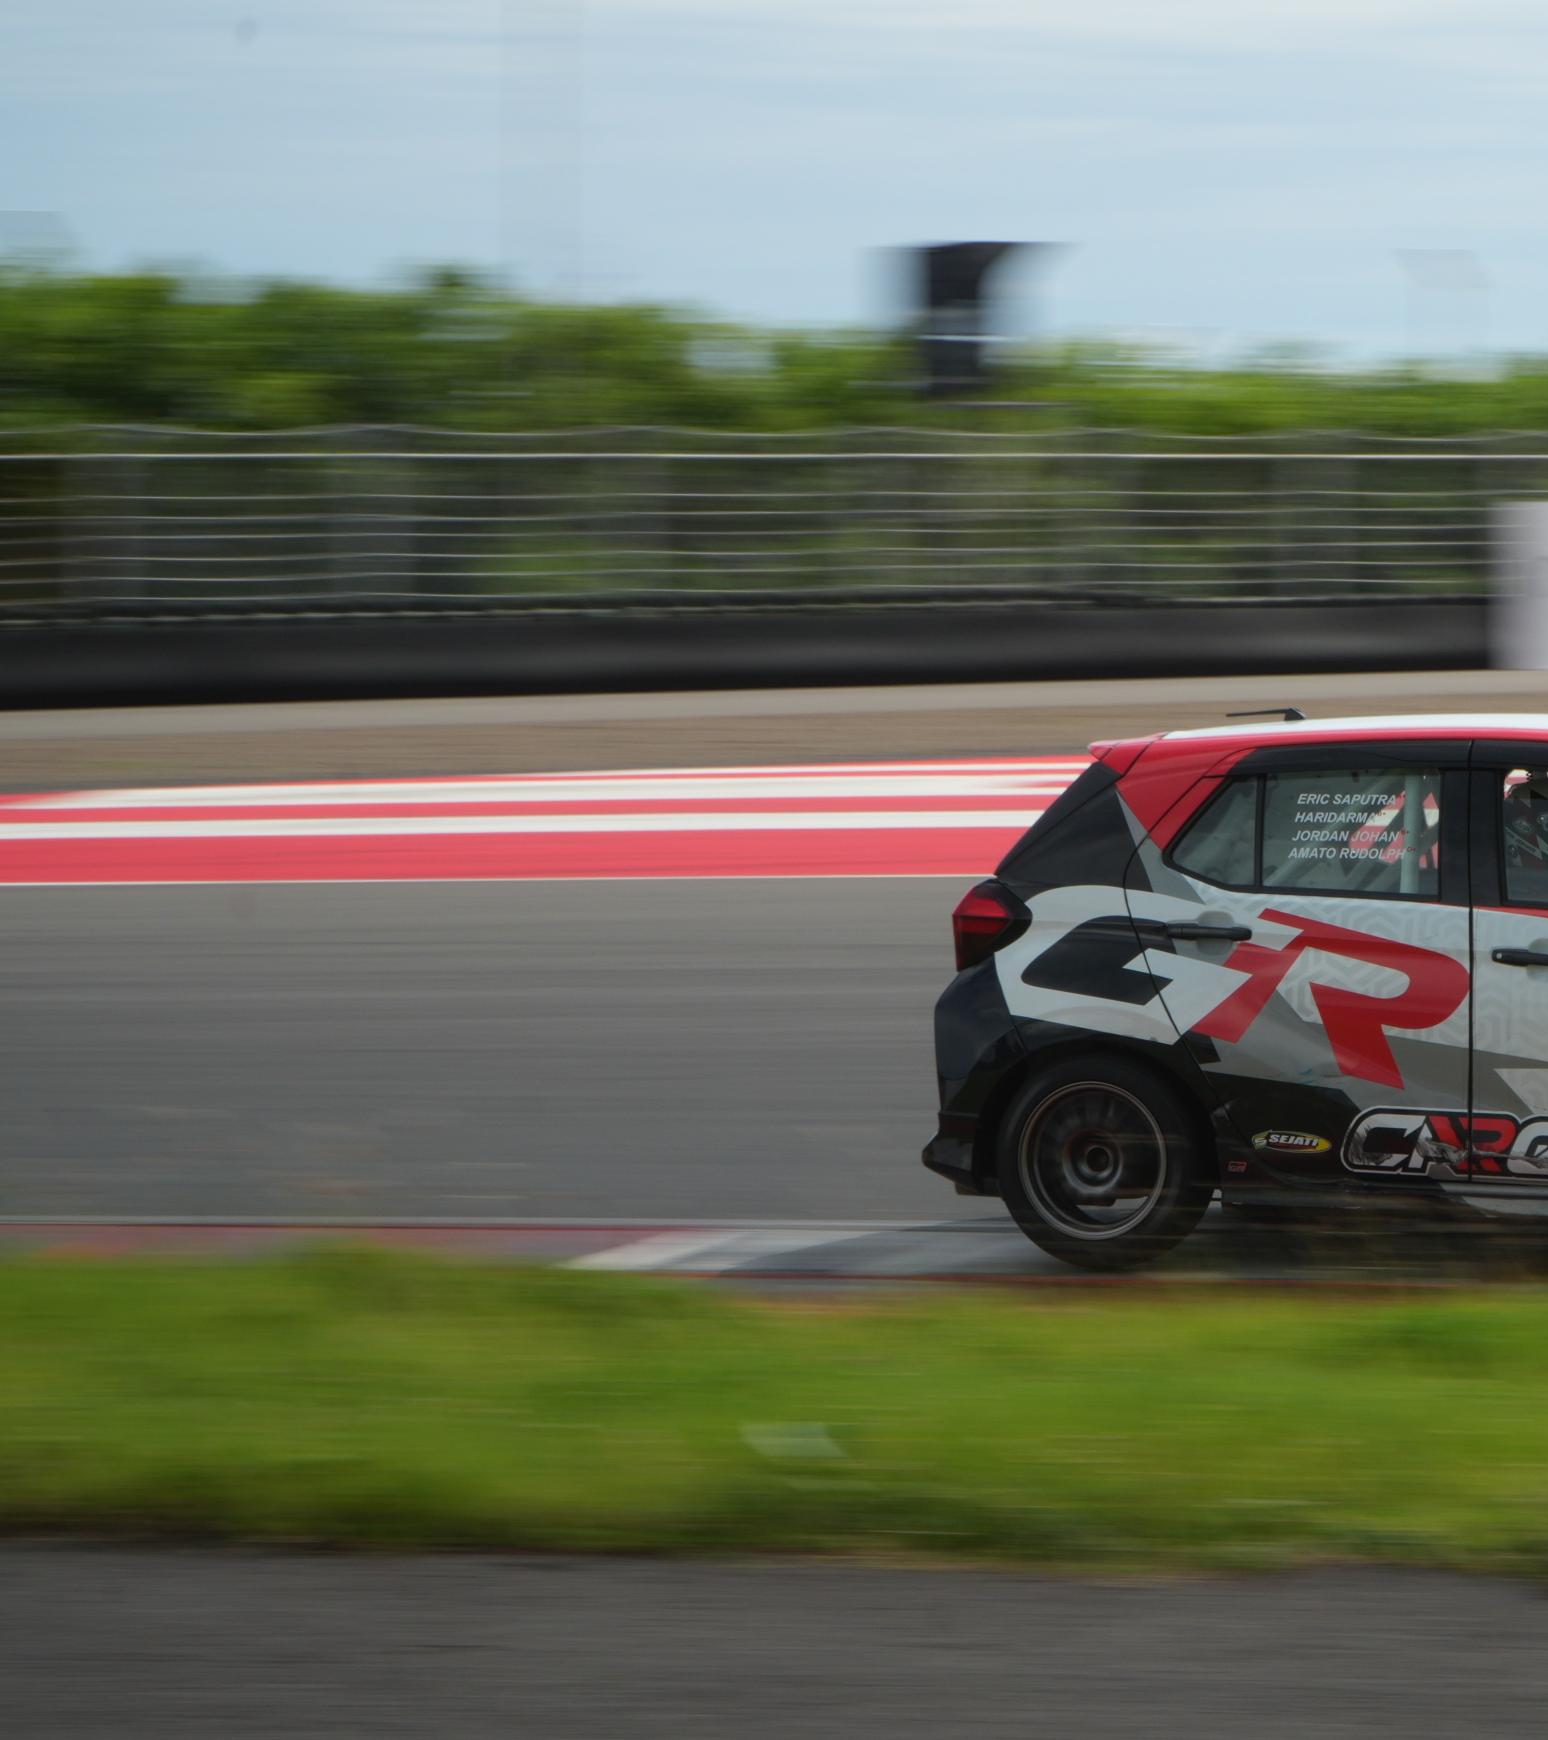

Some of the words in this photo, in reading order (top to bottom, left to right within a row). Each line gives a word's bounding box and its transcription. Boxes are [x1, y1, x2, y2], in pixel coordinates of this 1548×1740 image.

[1297, 793, 1330, 805] ERIC
[1332, 794, 1397, 806] SAPUTRA
[1294, 811, 1378, 824] HARIDARMA
[1291, 830, 1350, 842] JORDAN
[1351, 830, 1399, 842] JOHAN
[1288, 847, 1337, 859] AMATO
[1339, 848, 1406, 859] RUDOLPH
[994, 884, 1471, 1090] GR
[1268, 1134, 1319, 1146] SEJATI
